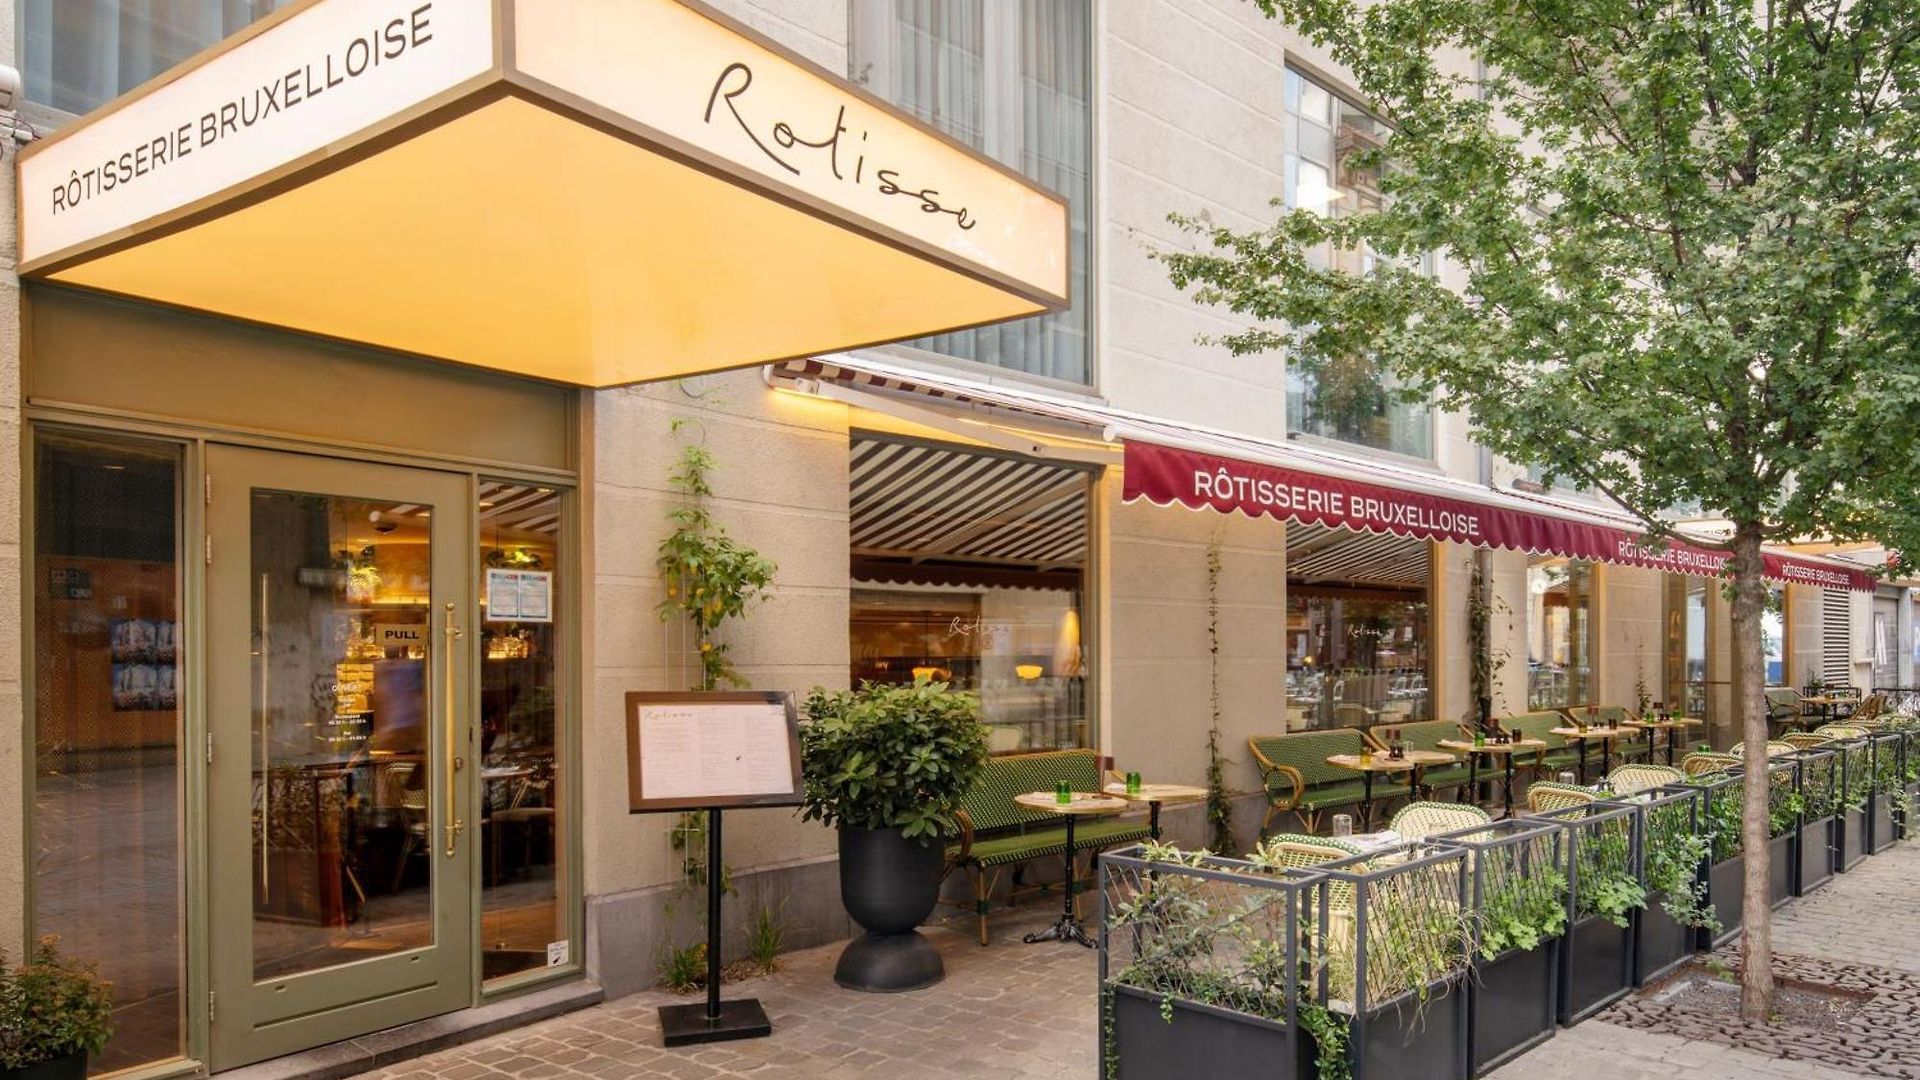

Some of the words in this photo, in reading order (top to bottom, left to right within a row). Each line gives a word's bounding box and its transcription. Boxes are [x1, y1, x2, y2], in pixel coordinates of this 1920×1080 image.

[52, 122, 192, 216] RÔTISSERIE
[200, 2, 433, 148] BRUXELLOISE
[703, 62, 976, 230] Rotisse
[1194, 467, 1345, 516] RÔTISSERIE
[1350, 495, 1480, 536] BRUXELLOISE
[1677, 550, 1728, 570] BRUXELLOIS
[384, 630, 420, 640] PULL
